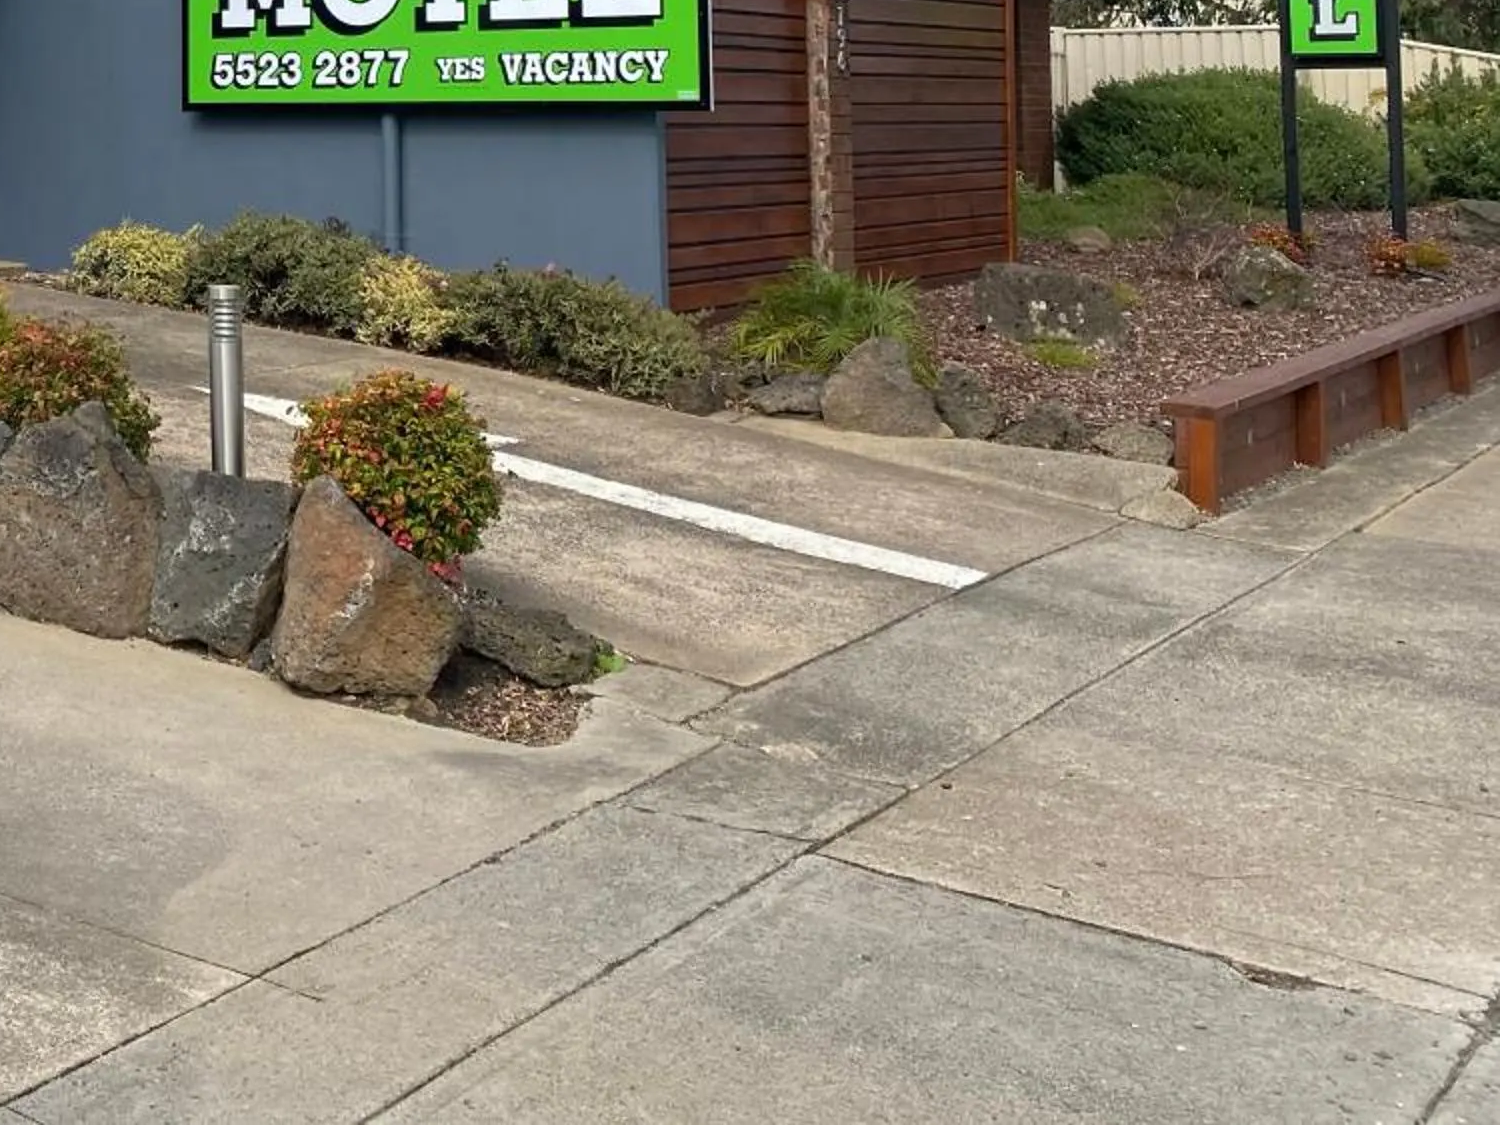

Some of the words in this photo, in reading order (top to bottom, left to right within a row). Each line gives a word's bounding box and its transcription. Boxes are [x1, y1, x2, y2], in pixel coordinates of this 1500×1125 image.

[212, 51, 301, 89] 5523
[312, 49, 409, 88] 2877
[436, 57, 485, 83] YES
[499, 49, 669, 85] VACANCY
